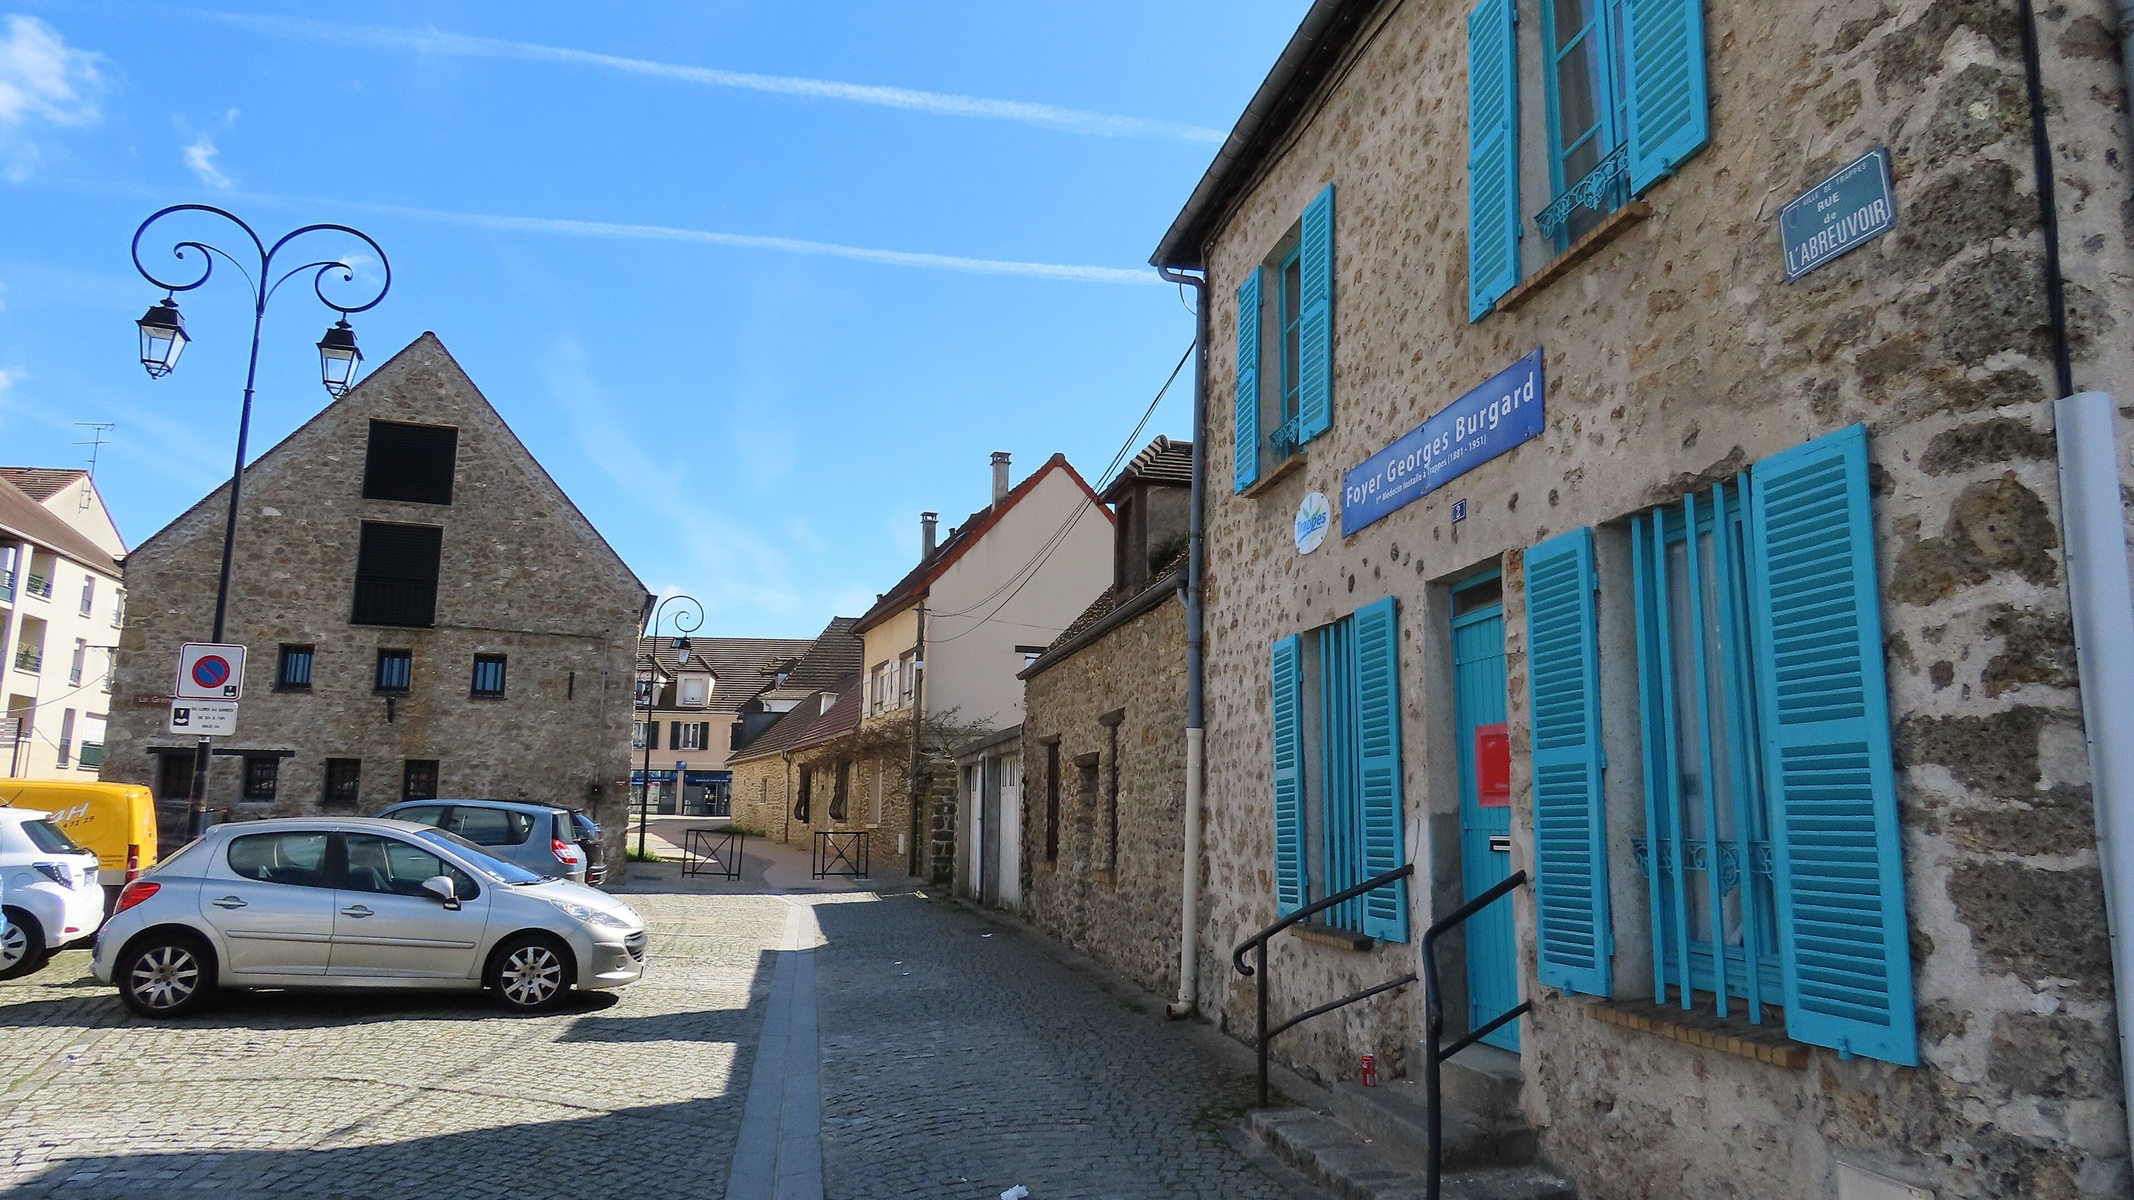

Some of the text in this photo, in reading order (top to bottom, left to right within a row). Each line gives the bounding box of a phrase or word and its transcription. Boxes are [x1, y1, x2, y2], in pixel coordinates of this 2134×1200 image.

[1803, 162, 1867, 206] VILLE DE TRAPPES
[1817, 192, 1840, 213] RUE
[1823, 211, 1837, 224] de
[1789, 199, 1886, 272] L'ABREUVOIR
[1346, 371, 1535, 508] Foyer Georges Burgard
[1382, 484, 1403, 502] Médecin
[1403, 475, 1422, 491] installé
[1427, 457, 1447, 477] Trappes
[1447, 446, 1463, 465] (1881
[1469, 434, 1487, 452] 1951)
[1297, 511, 1326, 536] Trappes
[1455, 505, 1461, 518] 2
[50, 803, 90, 823] 4H
